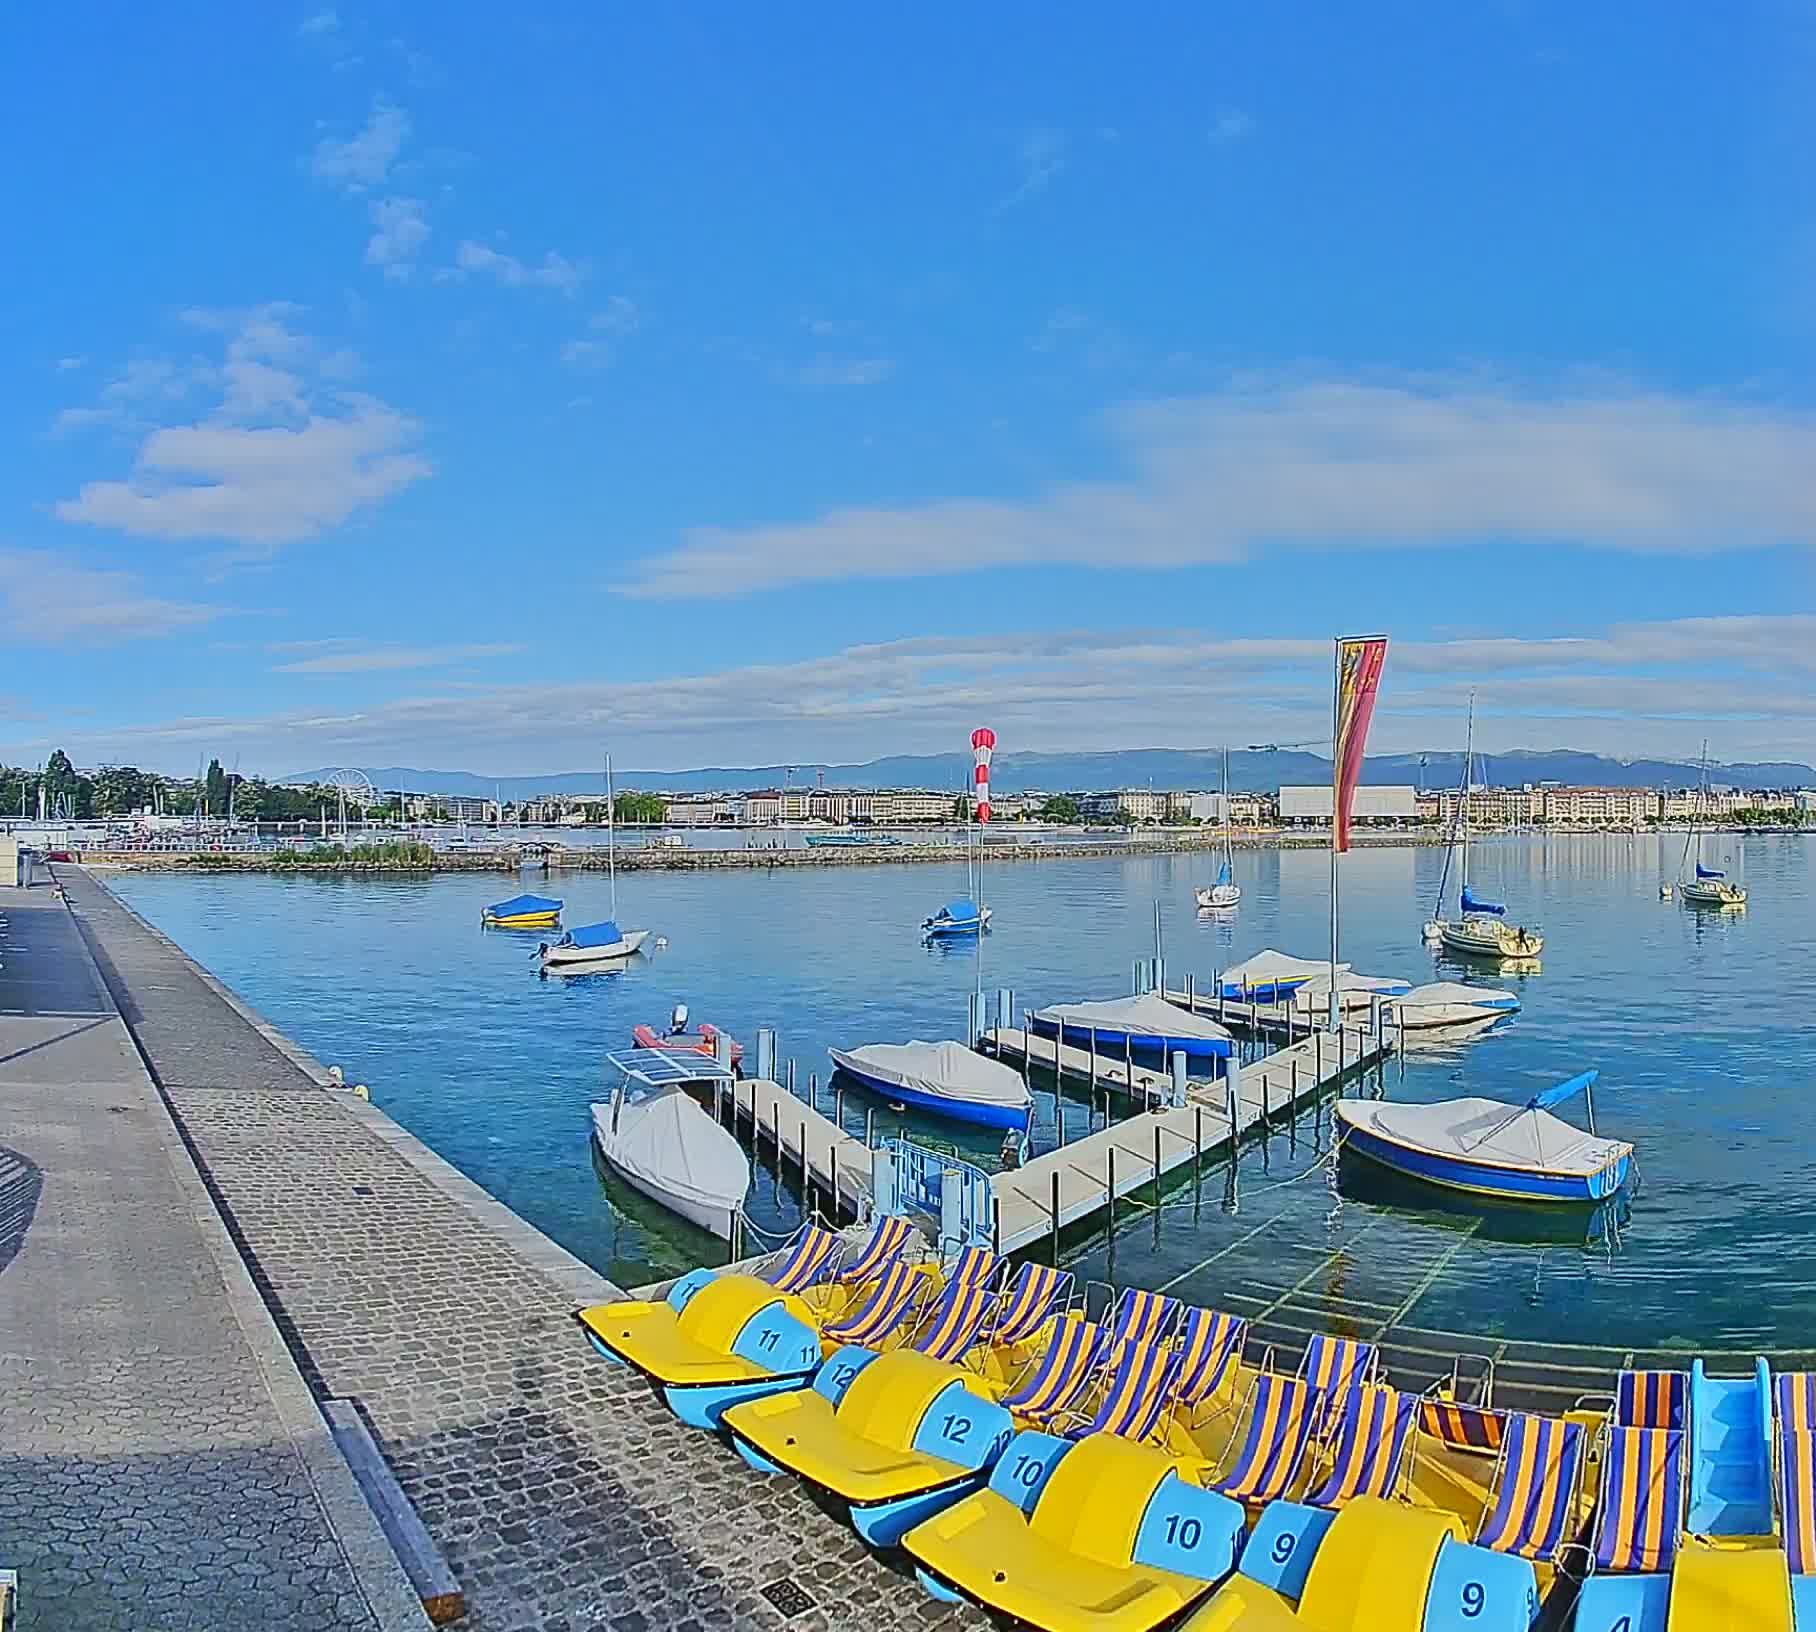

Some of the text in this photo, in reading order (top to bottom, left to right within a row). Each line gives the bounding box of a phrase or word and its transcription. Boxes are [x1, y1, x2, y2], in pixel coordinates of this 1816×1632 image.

[759, 1329, 780, 1352] 11
[800, 1345, 816, 1364] 11
[832, 1363, 857, 1389] 12
[942, 1414, 972, 1444] 12
[1012, 1455, 1044, 1487] 10
[1166, 1515, 1201, 1549] 10
[1271, 1533, 1297, 1564] 9
[1461, 1582, 1486, 1617] 9
